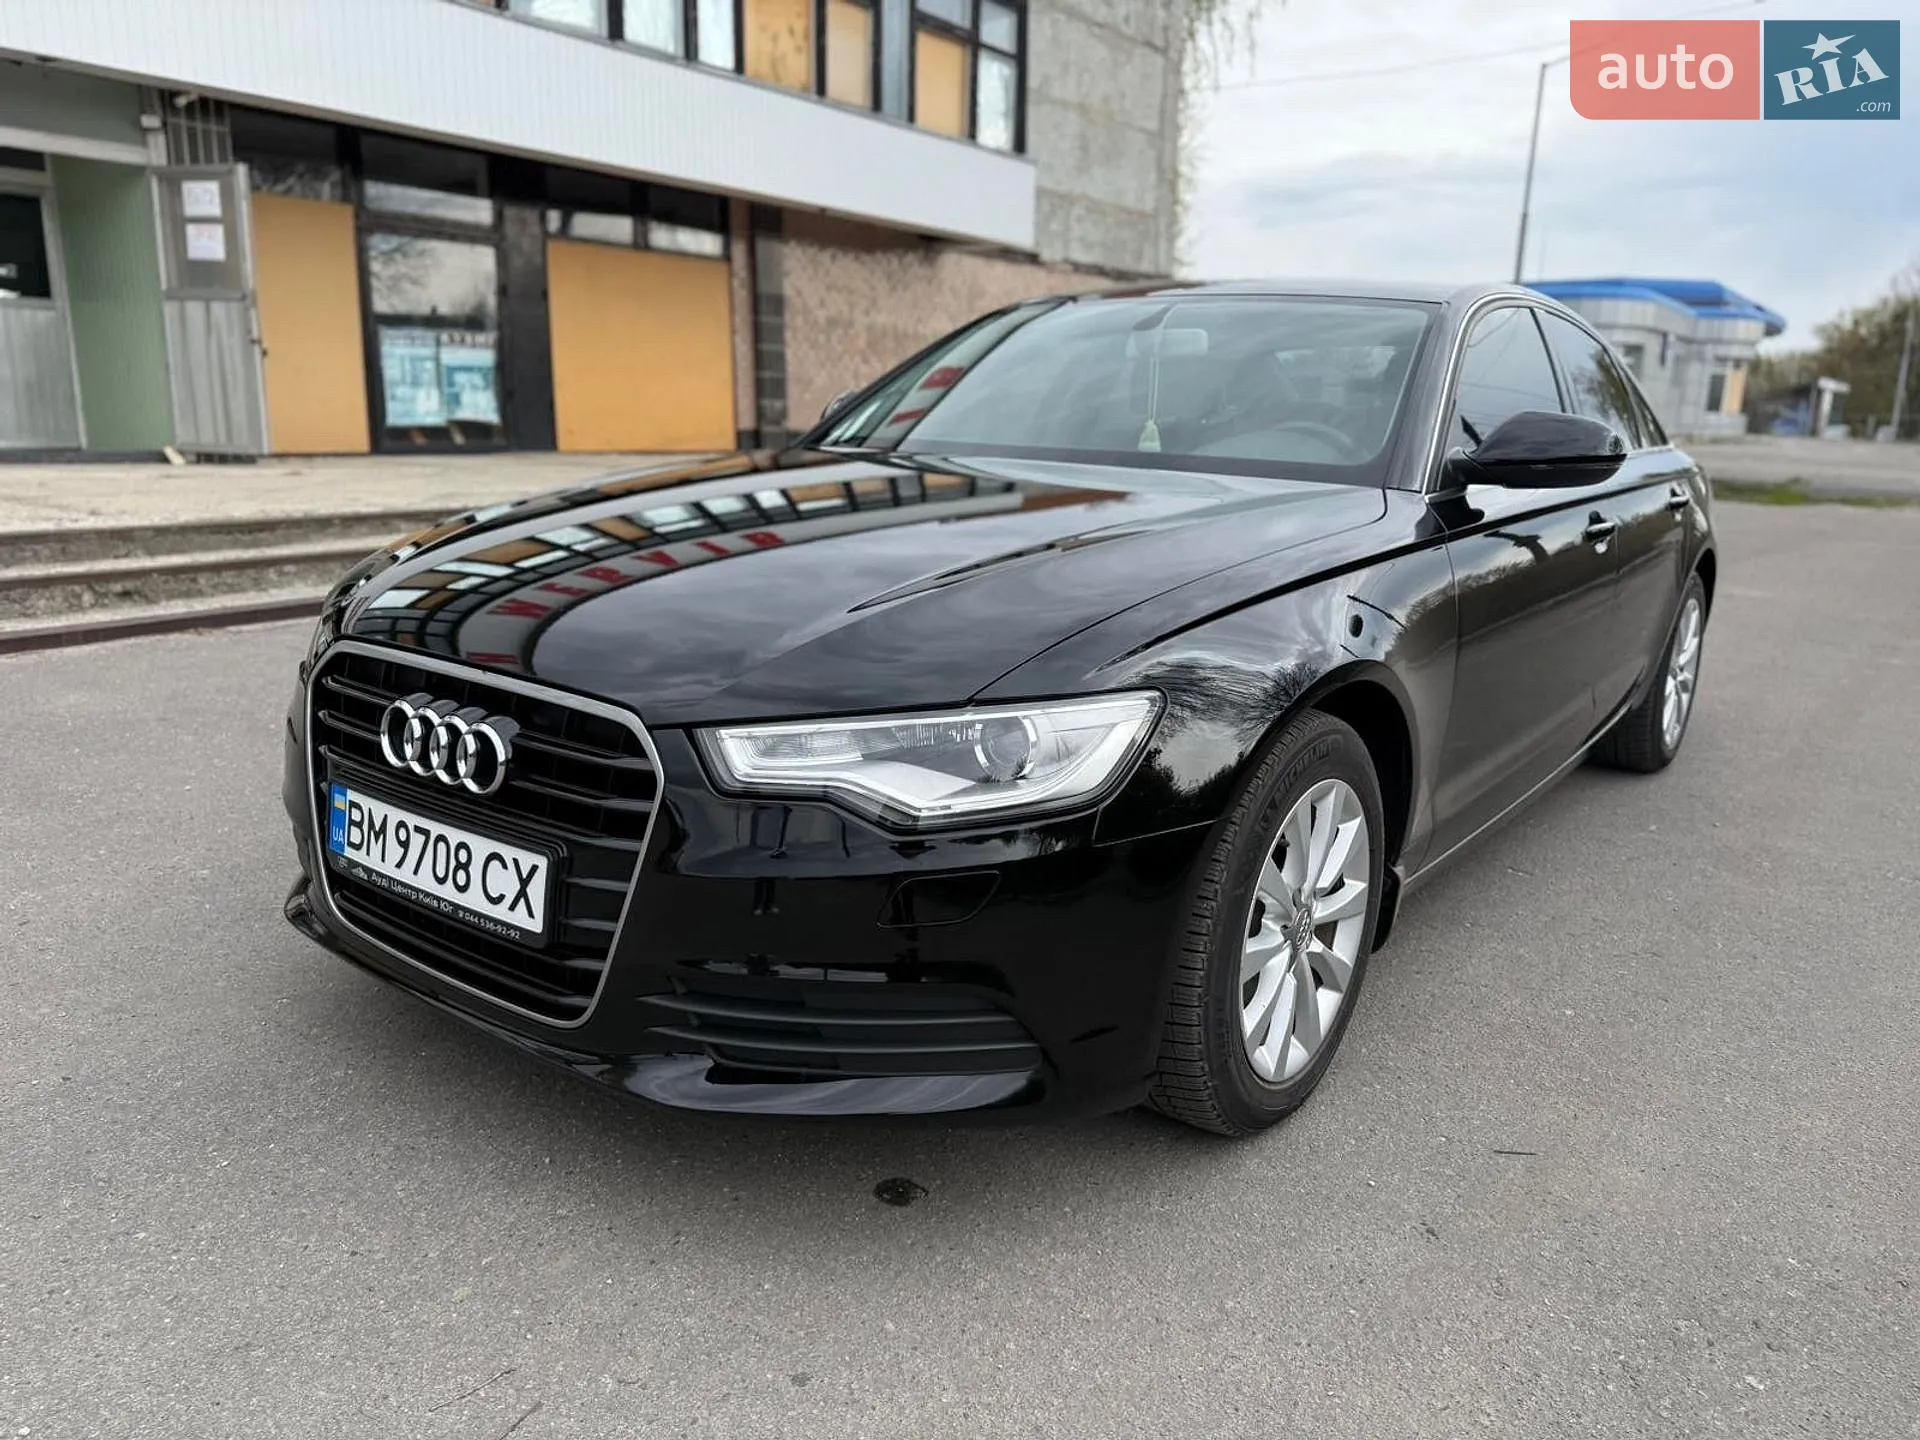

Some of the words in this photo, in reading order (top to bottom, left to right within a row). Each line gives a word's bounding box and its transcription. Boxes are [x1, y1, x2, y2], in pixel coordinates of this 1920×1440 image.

[332, 828, 345, 843] UA
[347, 799, 388, 863] BM
[394, 820, 473, 893] 9708
[481, 851, 539, 919] CX
[391, 880, 417, 900] Центр
